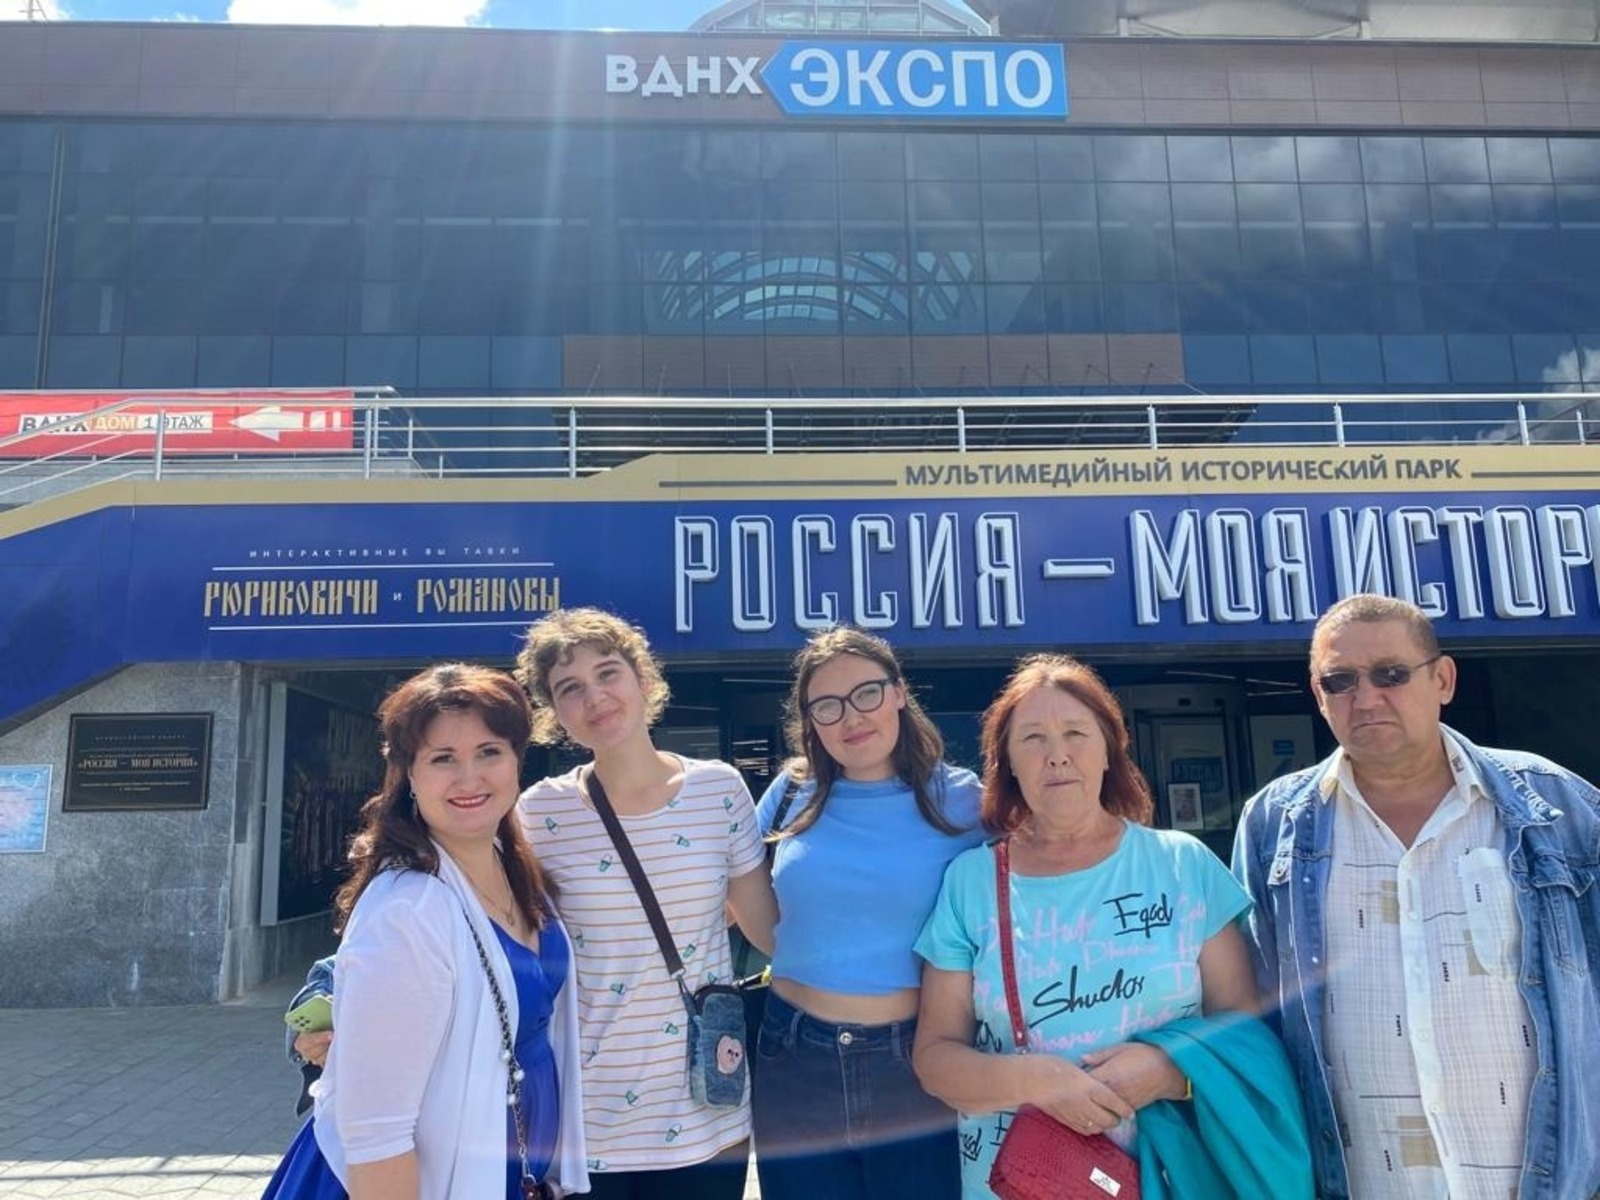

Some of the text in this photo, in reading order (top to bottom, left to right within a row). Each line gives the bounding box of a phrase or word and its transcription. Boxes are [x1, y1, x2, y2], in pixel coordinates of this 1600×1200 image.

[605, 48, 1053, 108] ВДНХ ЭКСПО
[95, 415, 137, 430] ДОМ
[145, 417, 152, 429] 1
[905, 454, 1462, 487] МУЛЬТИМЕДИЙНЫЙ ИСТОРИЧЕСКИЙ ПАРК
[250, 548, 408, 558] ИНТЕРАКТИВНЫЕ
[675, 511, 1025, 633] РОССИЯ
[1130, 506, 1318, 625] МОЯ
[1328, 504, 1600, 619] ИСТОР
[204, 579, 378, 617] РЮРИКОВИЧИ
[417, 577, 560, 614] РОМАНОВЫ
